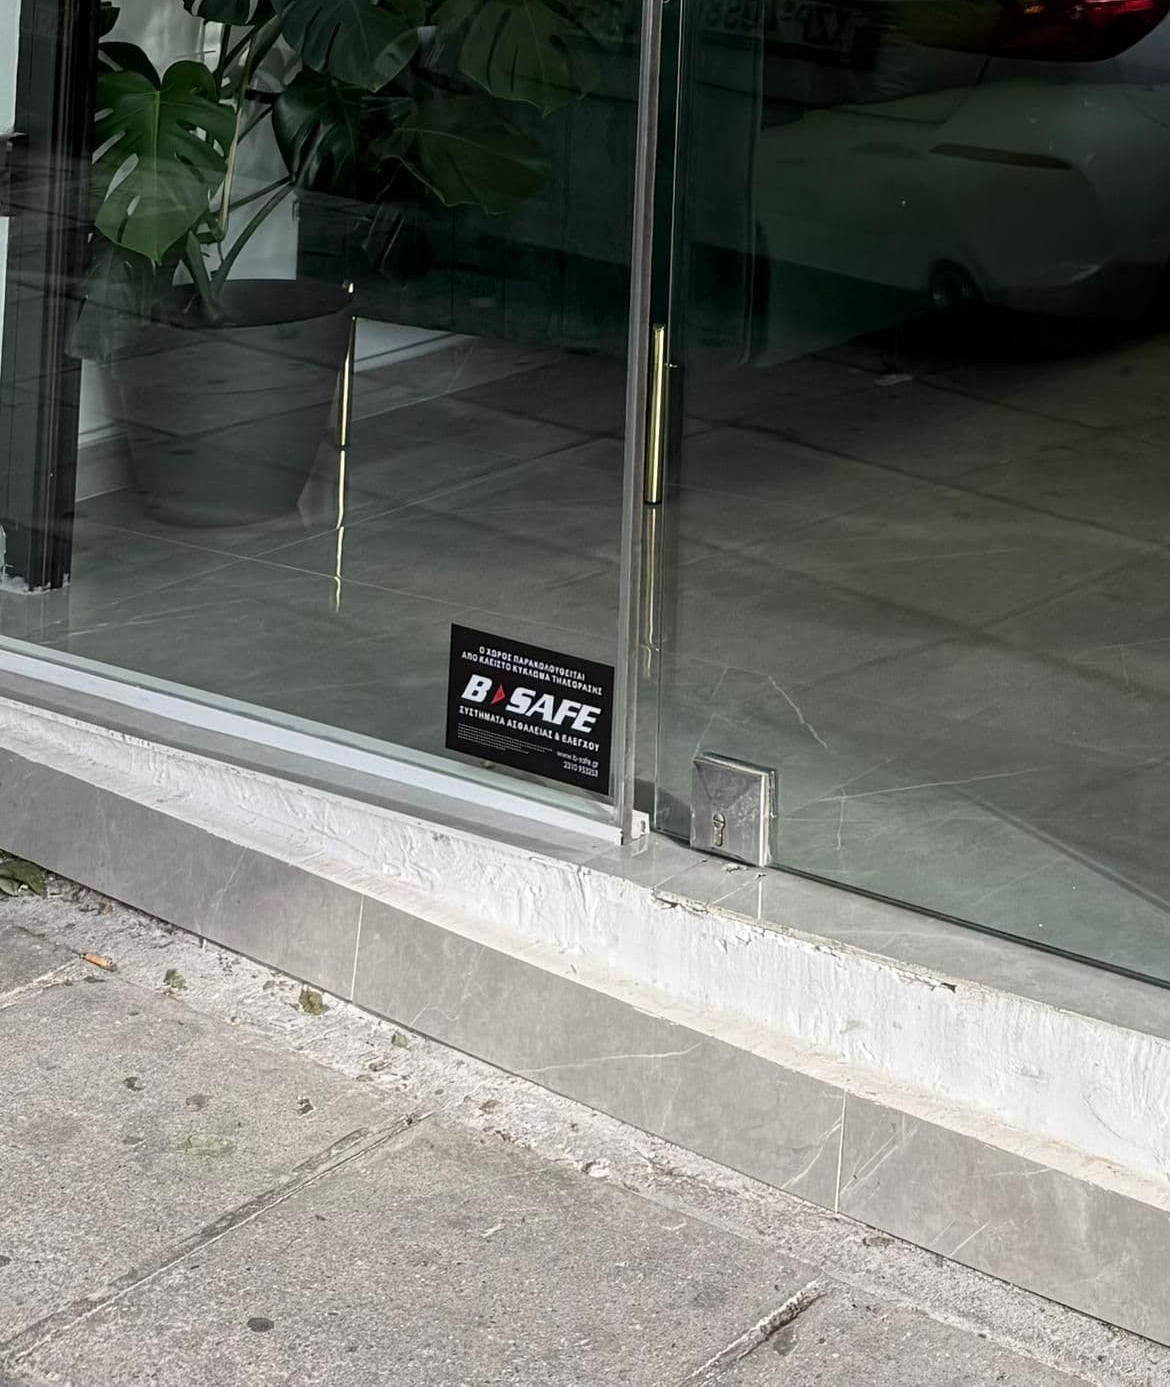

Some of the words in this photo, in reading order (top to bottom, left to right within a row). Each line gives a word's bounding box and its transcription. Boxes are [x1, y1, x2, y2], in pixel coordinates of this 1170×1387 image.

[462, 651, 478, 662] ΑΠΟ
[479, 655, 511, 671] ΚΛΕΙΣΤΟ
[459, 705, 505, 725] ΣΥΣΤΗΜΑΤΑ
[562, 734, 600, 752] ΕΛΕΓΧΟΥ
[505, 686, 602, 733] SAFE
